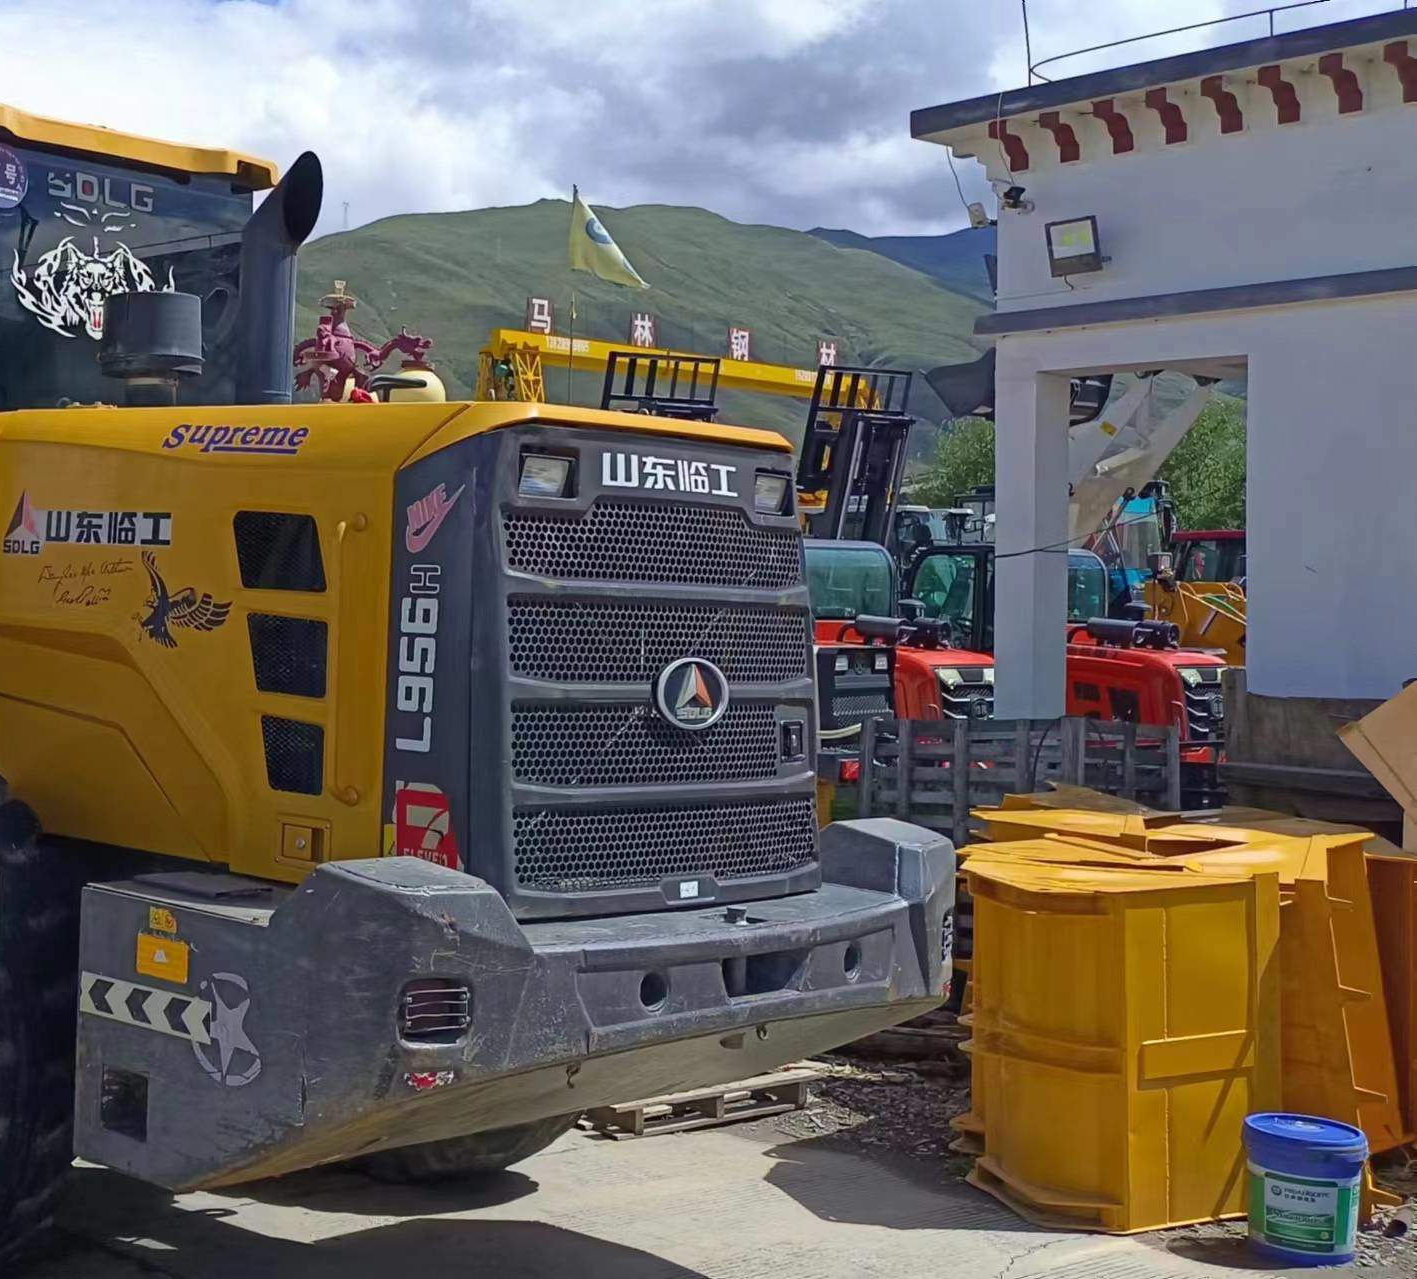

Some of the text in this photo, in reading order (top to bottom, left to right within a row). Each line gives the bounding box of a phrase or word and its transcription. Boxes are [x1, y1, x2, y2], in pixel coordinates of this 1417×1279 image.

[48, 171, 154, 213] SDLG
[162, 423, 310, 454] Supreme
[602, 452, 739, 497] 山东临工
[2, 539, 40, 555] SDLG
[45, 510, 172, 546] 山东临工
[395, 564, 442, 753] L956H
